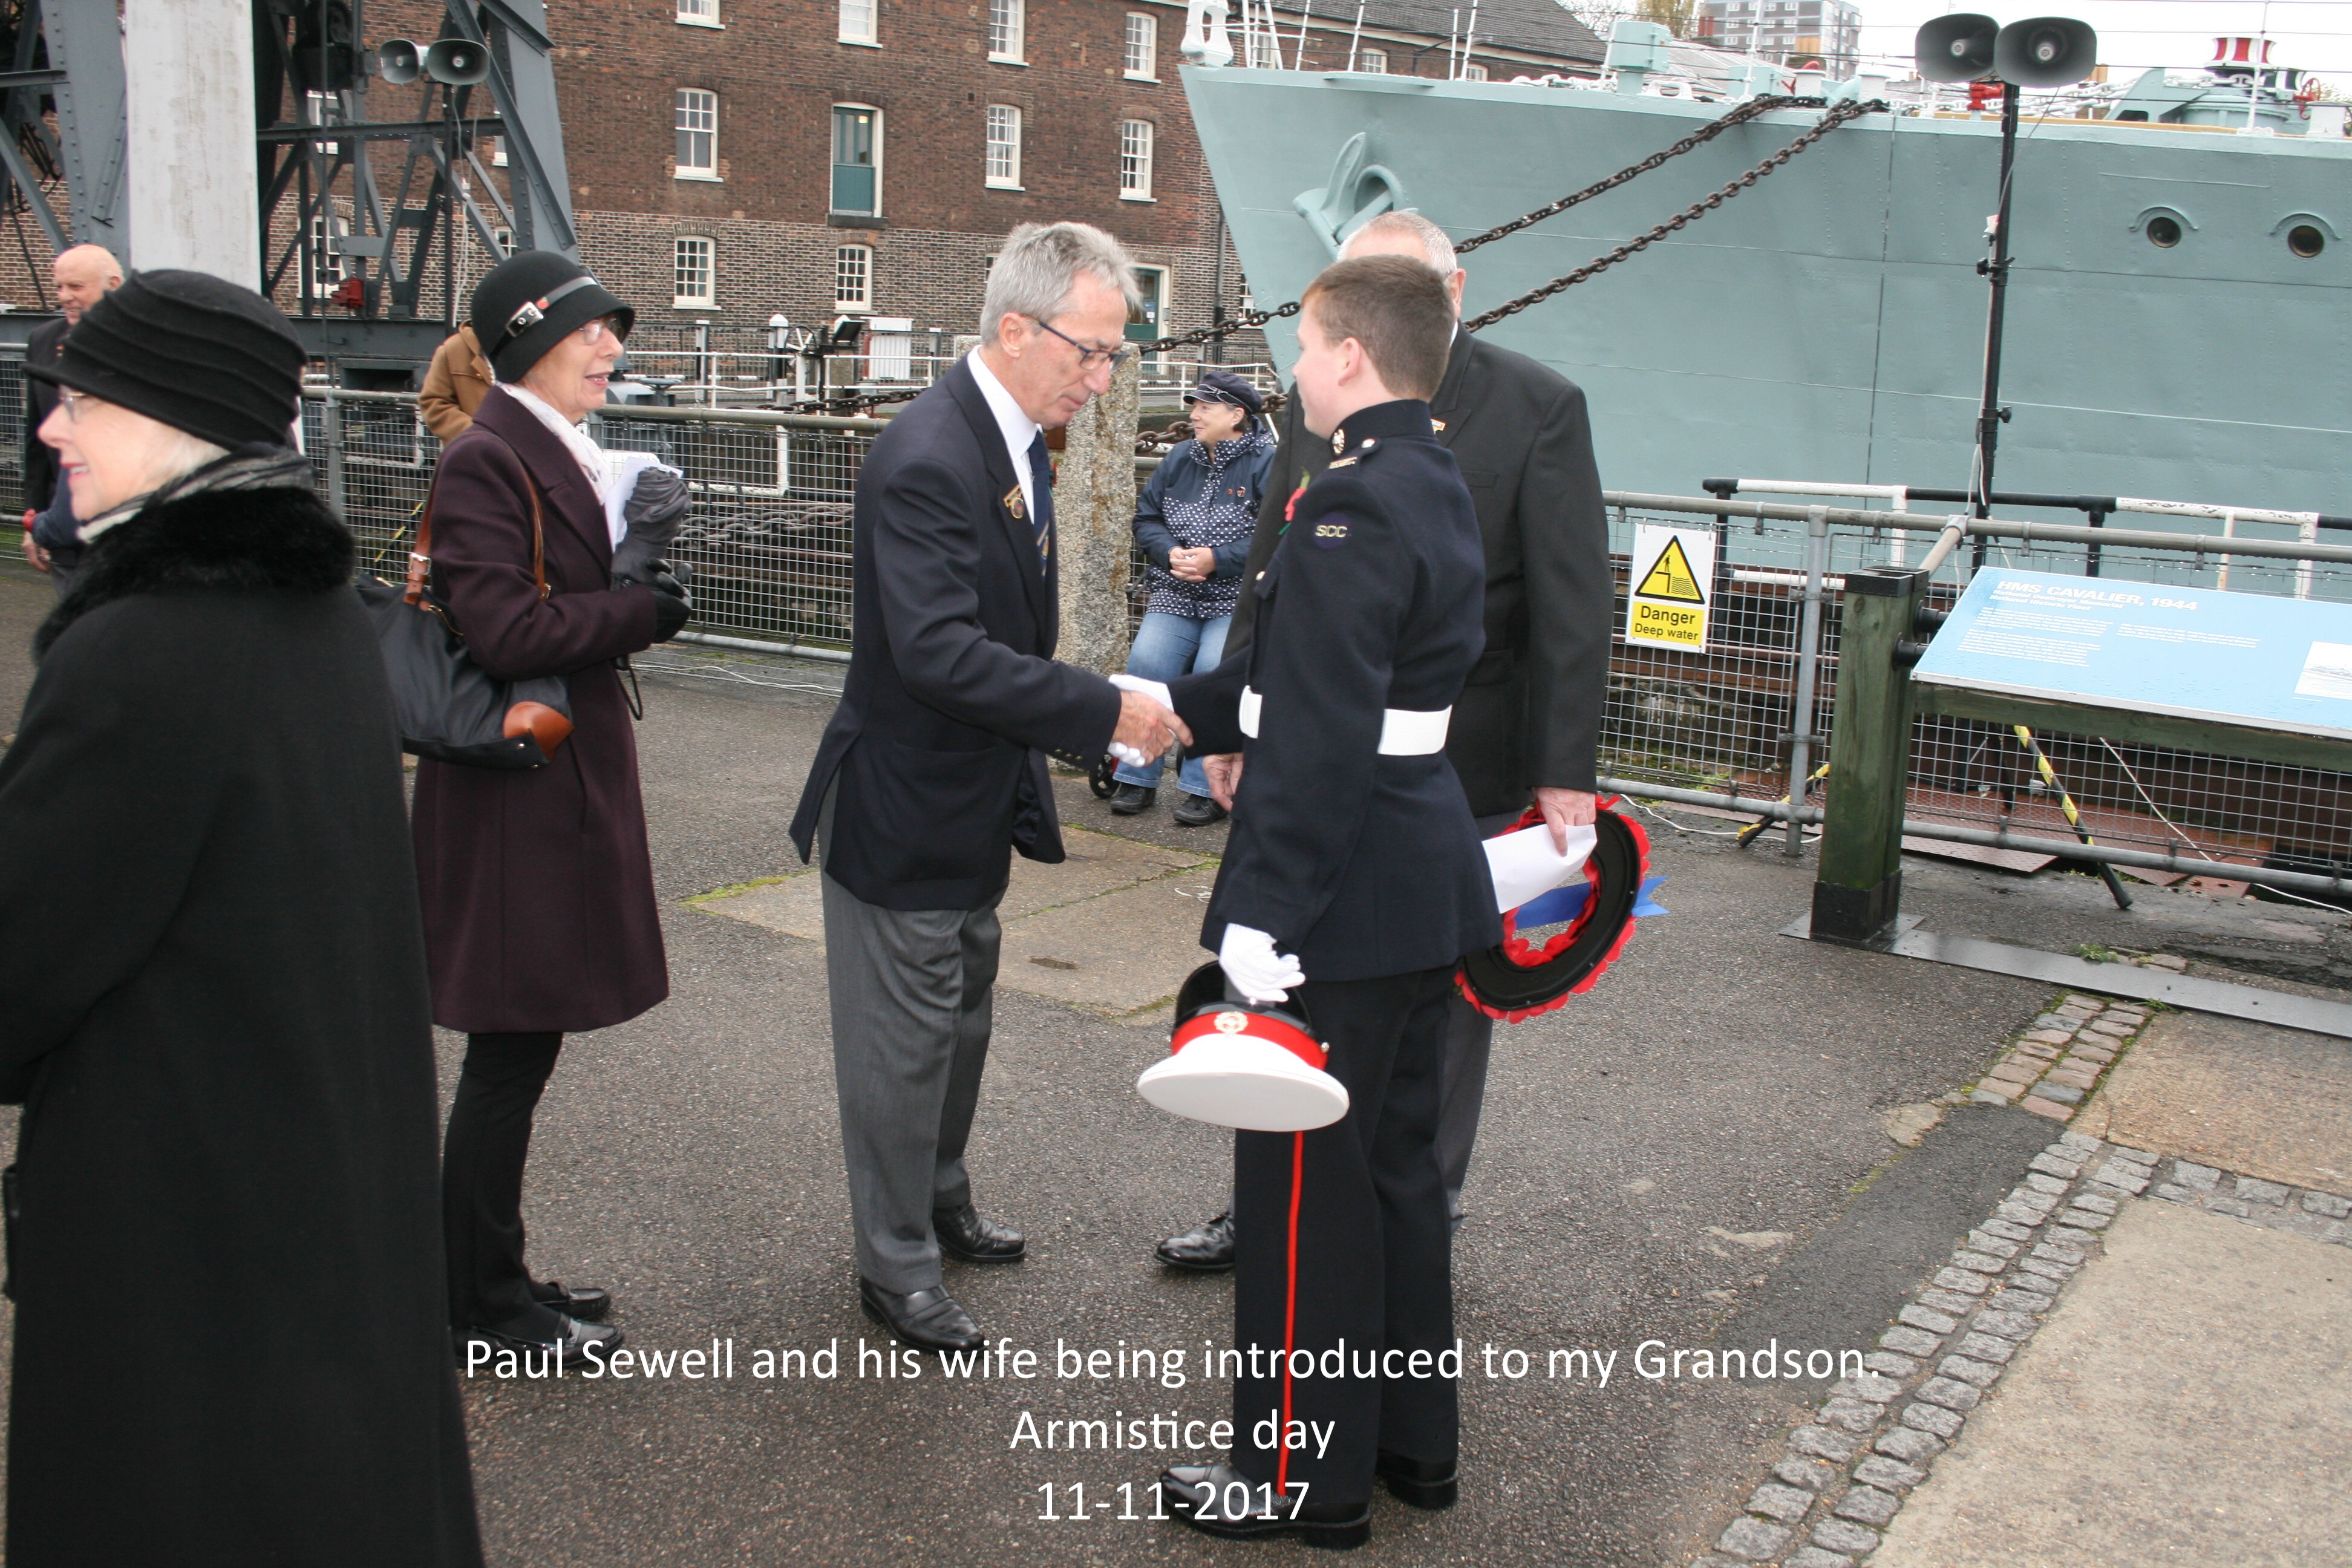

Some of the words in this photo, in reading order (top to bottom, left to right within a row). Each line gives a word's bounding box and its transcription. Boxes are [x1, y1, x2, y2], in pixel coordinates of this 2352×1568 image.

[1315, 525, 1348, 538] SCC
[1990, 595, 2028, 603] National
[1993, 590, 2031, 598] National
[1996, 581, 2042, 593] HMS
[2047, 586, 2145, 606] CAVALIER,
[2151, 597, 2198, 610] 1944
[1641, 606, 1696, 626] Danger
[1635, 623, 1664, 638] Deep
[1667, 629, 1699, 641] water
